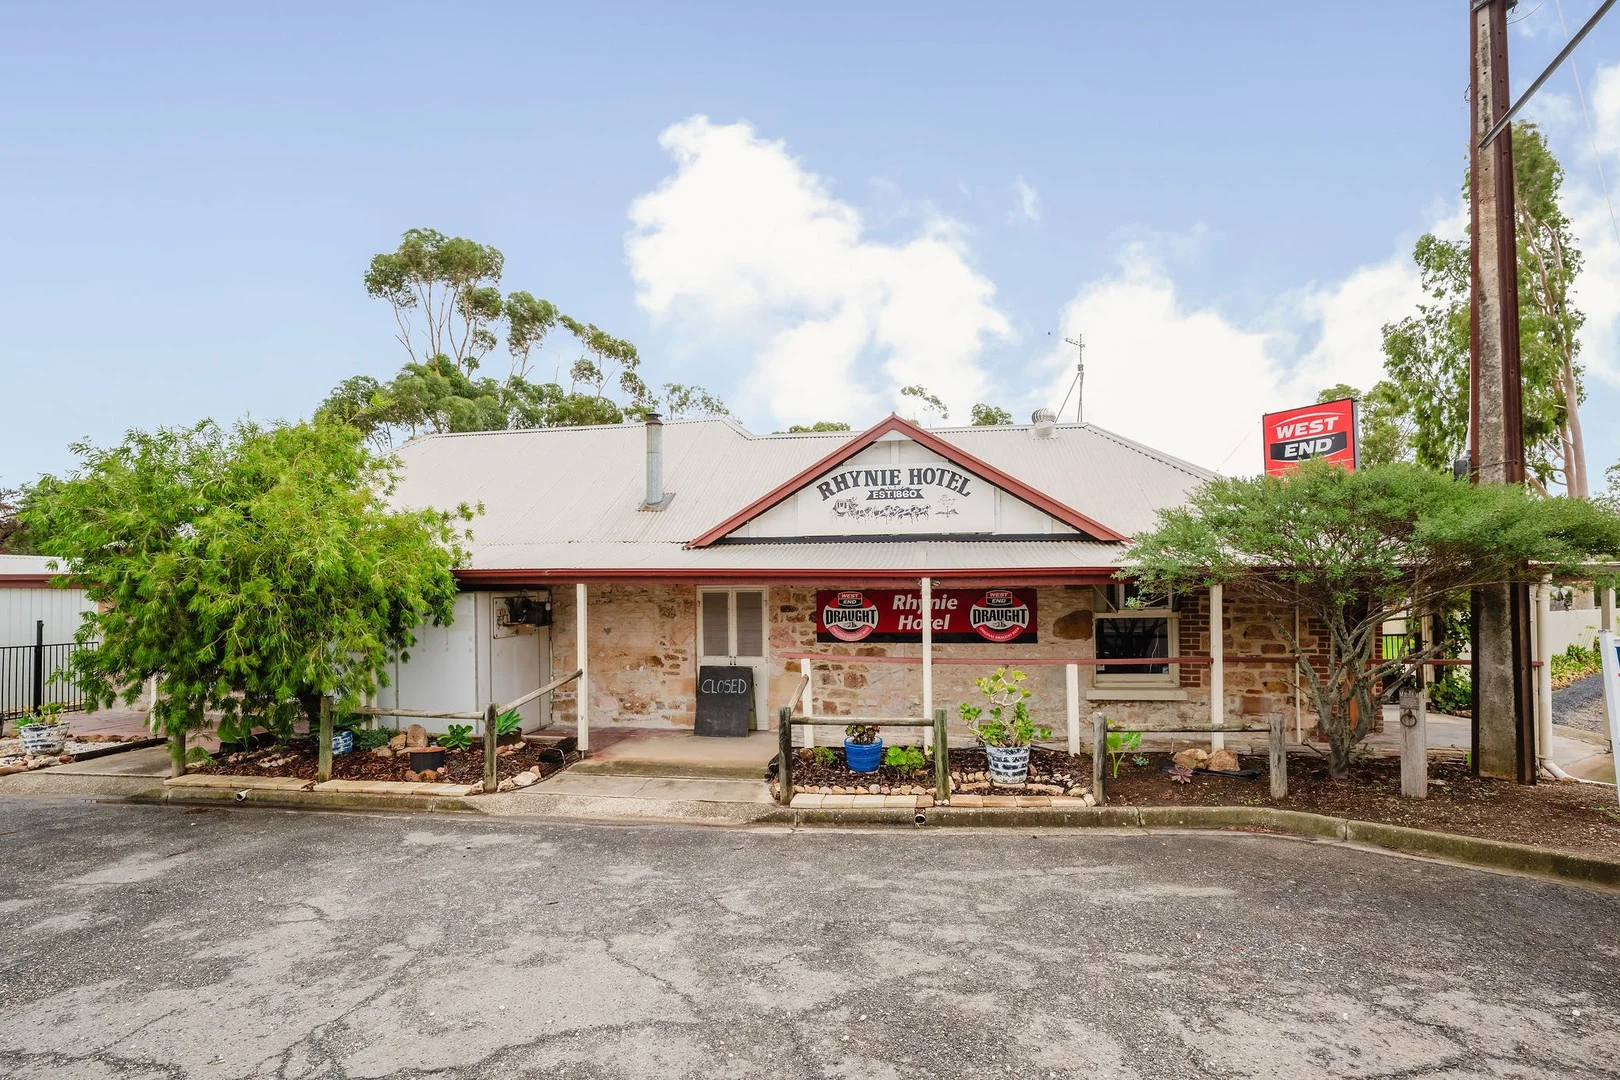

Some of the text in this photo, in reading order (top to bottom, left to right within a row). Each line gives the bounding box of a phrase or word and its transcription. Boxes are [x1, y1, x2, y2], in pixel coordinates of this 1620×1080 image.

[1275, 416, 1339, 440] WEST
[1284, 438, 1333, 458] END
[816, 467, 972, 502] RHYNIE HOTEL
[825, 609, 877, 626] DRAUGHT
[898, 614, 951, 630] Hoel
[973, 608, 1027, 625] DRAUGHT
[701, 678, 747, 694] CLOSED
